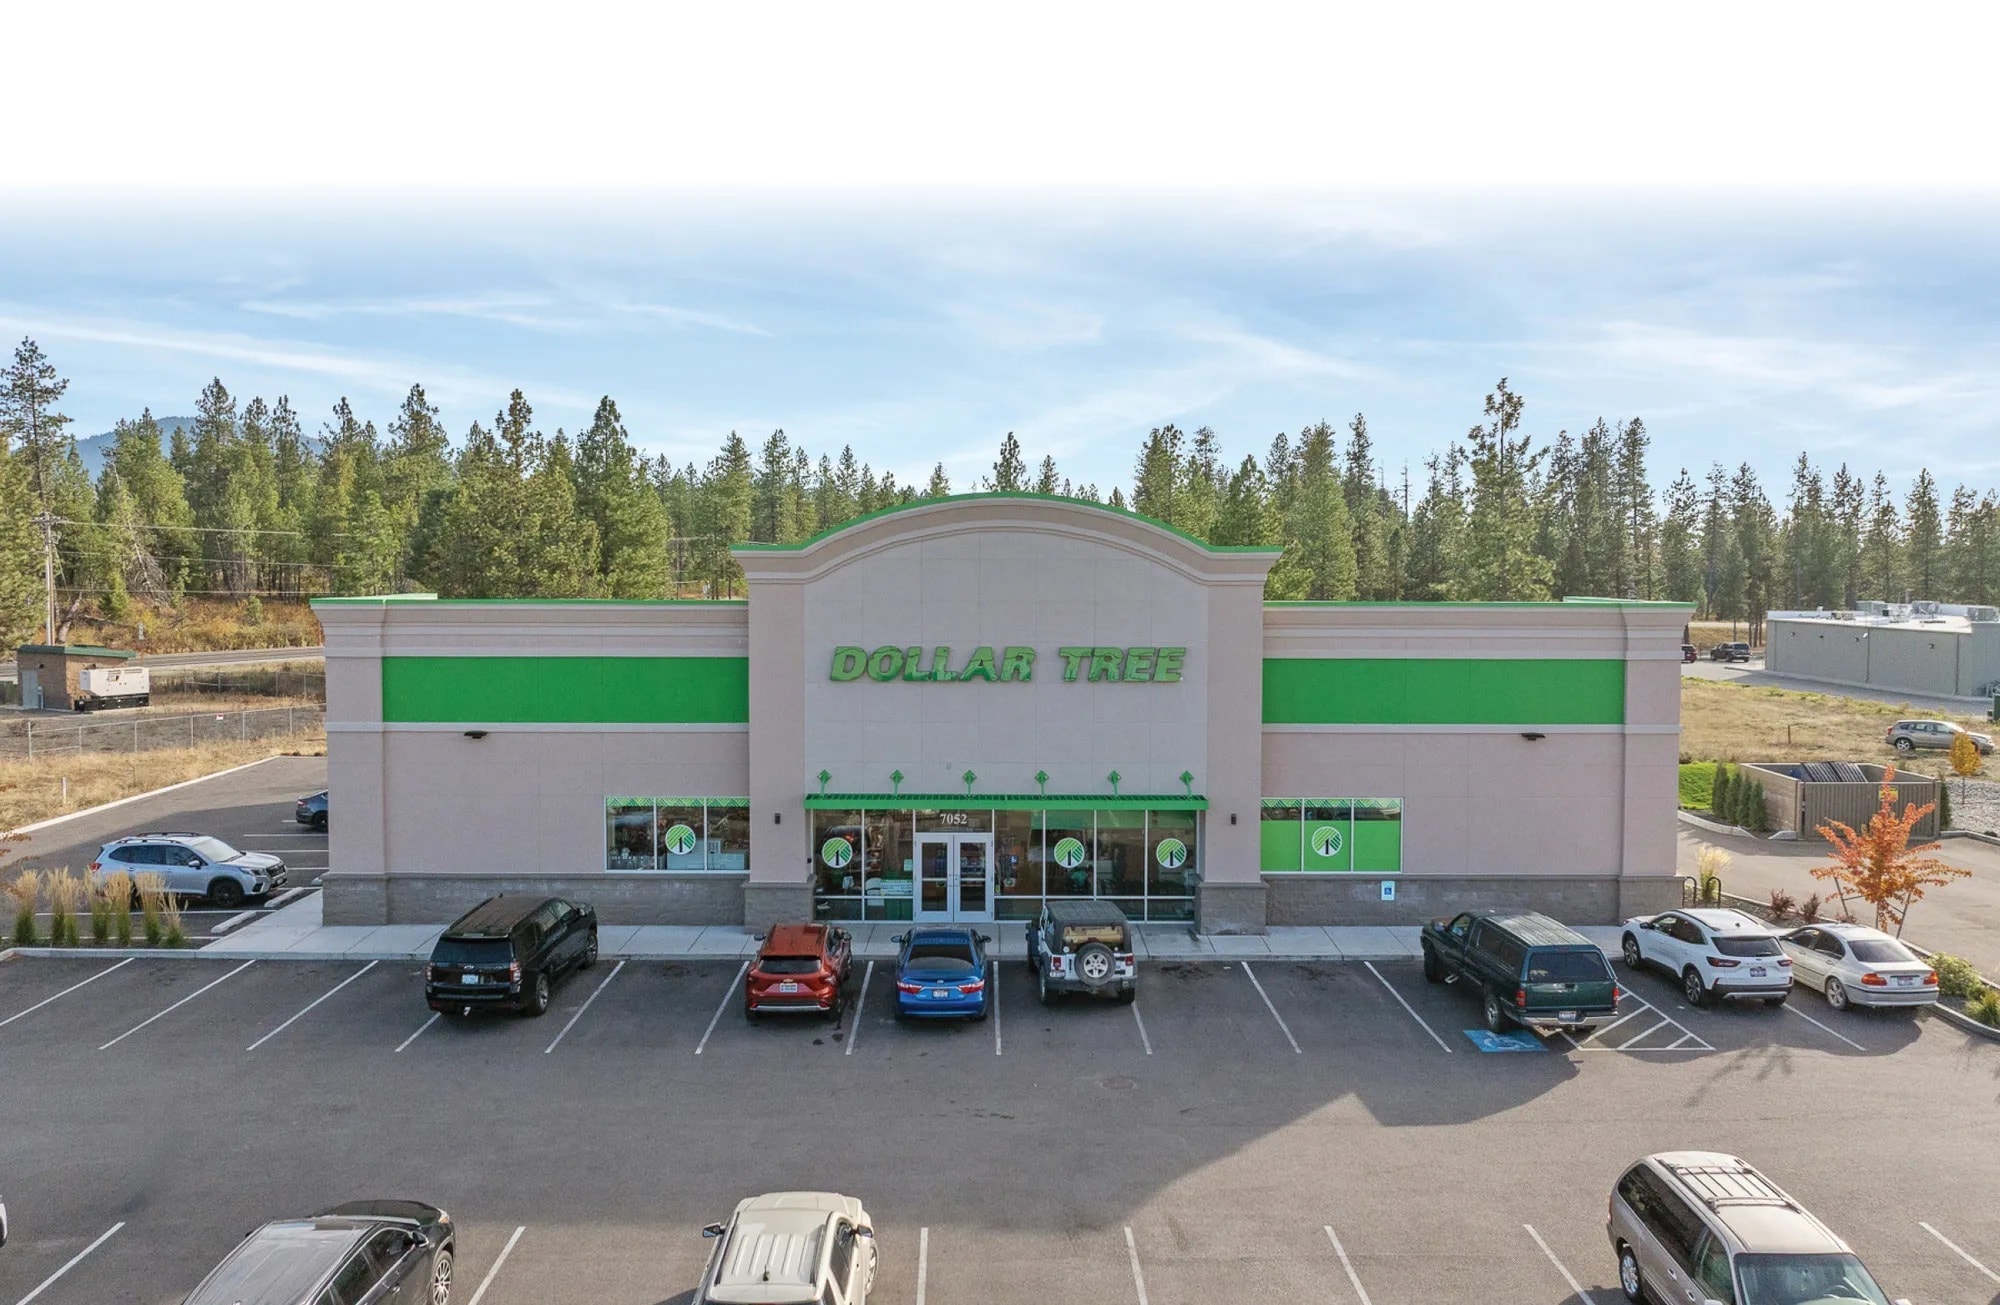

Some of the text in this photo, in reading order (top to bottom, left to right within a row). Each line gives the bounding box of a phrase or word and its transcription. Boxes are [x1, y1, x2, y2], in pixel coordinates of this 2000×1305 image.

[829, 645, 1187, 682] DOLLAR TREE
[940, 813, 968, 825] 7052
